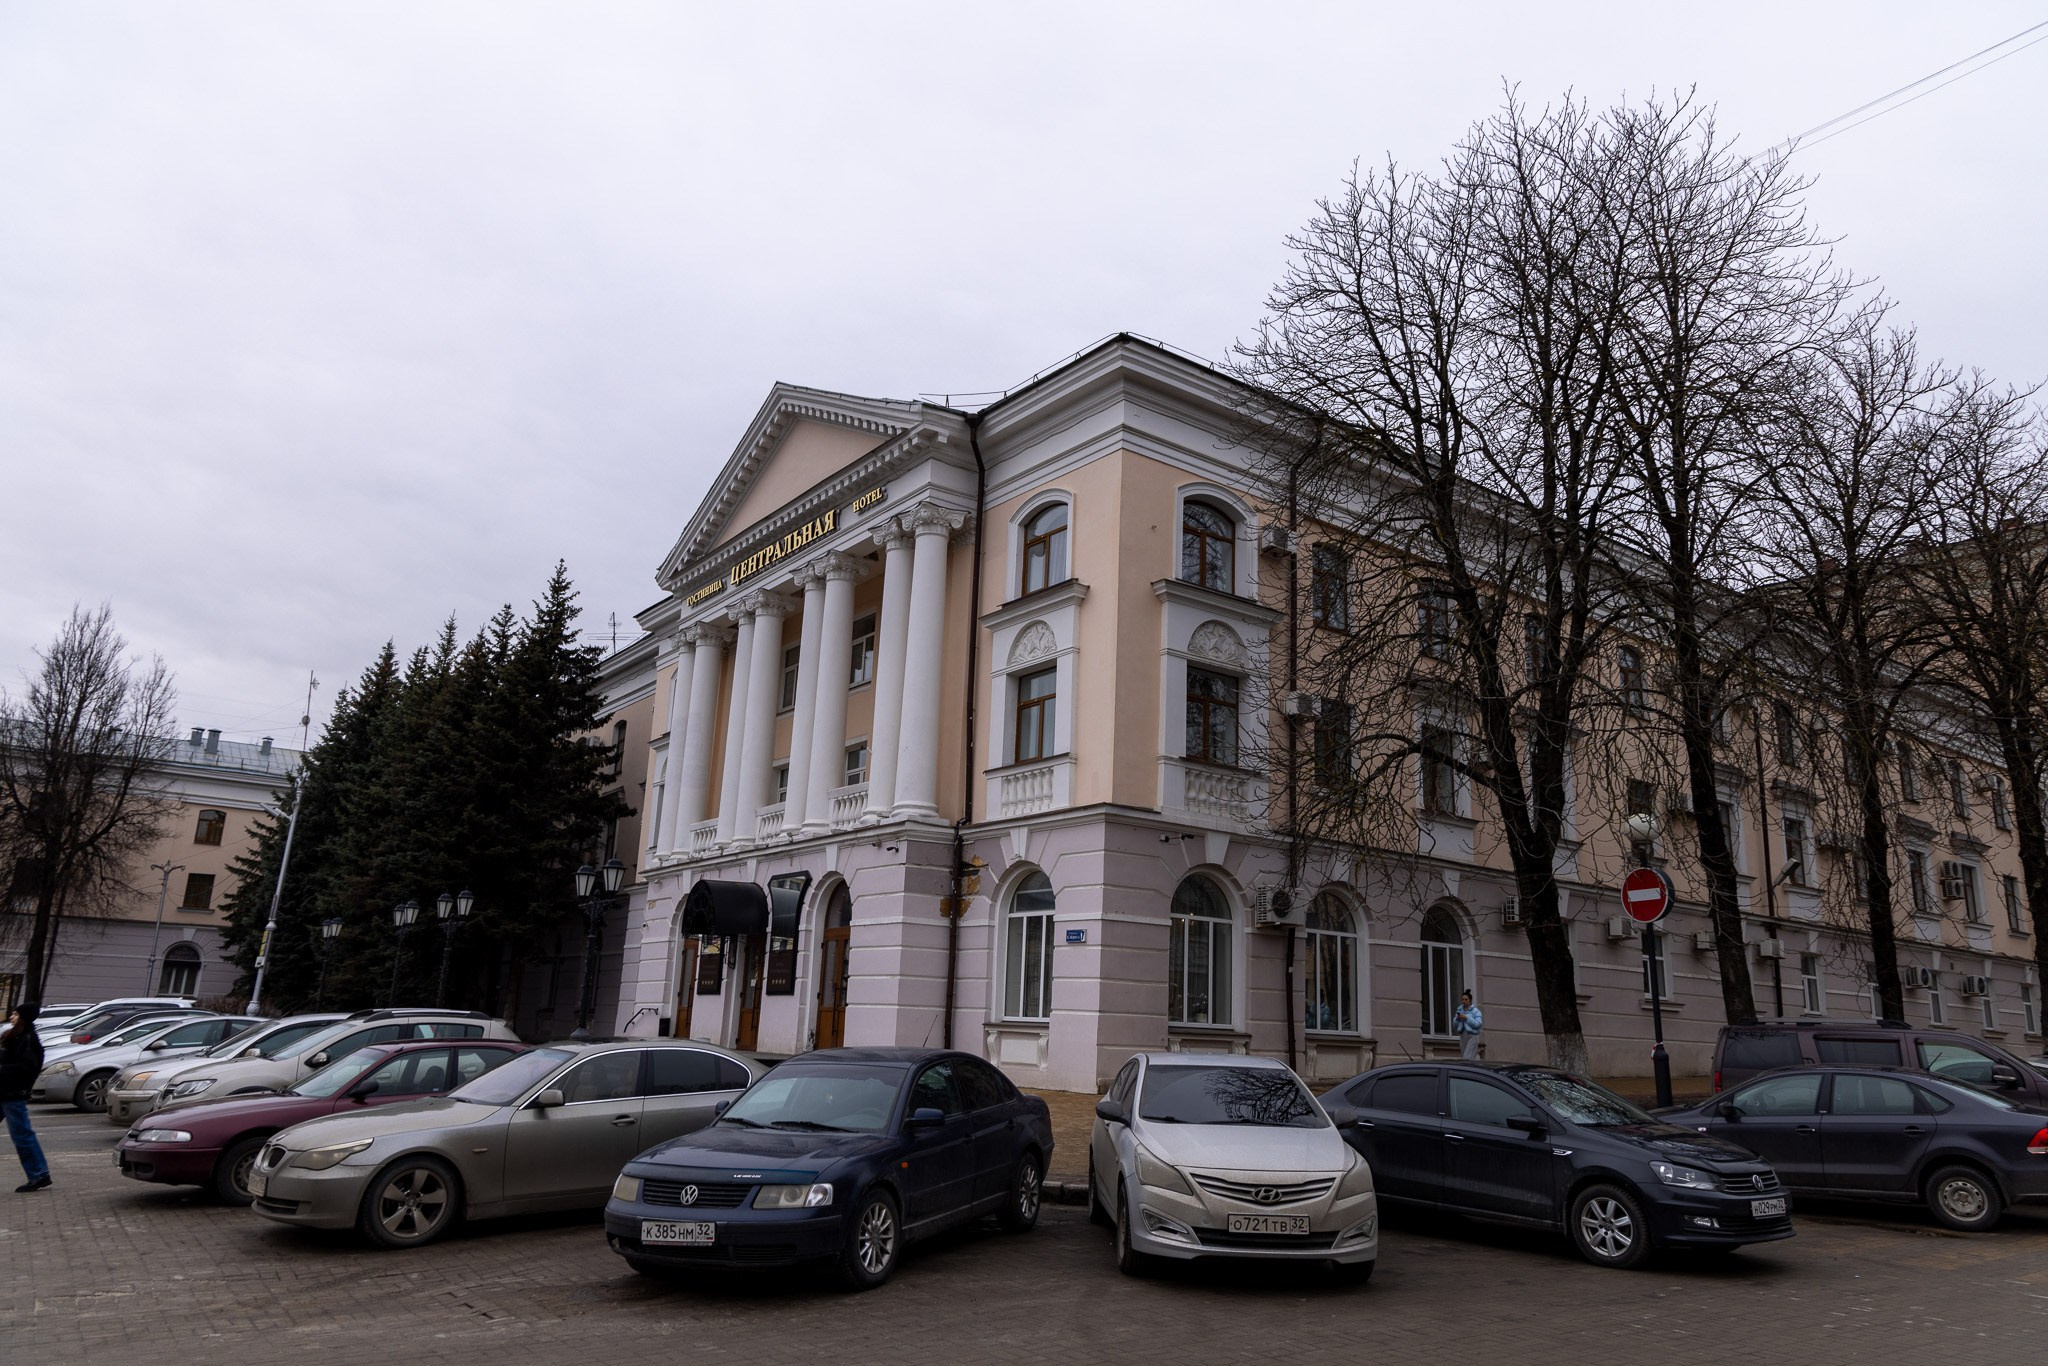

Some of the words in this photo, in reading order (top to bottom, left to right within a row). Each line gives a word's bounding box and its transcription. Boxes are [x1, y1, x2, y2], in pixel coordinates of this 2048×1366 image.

[853, 487, 882, 513] HOTEL
[686, 579, 723, 607] ГОСТИНИЦА
[730, 509, 835, 586] ЦЕНТРАЛЬНАЯ
[646, 1224, 694, 1240] К385НМ
[697, 1224, 710, 1236] 32
[1233, 1217, 1288, 1232] О721ТВ
[1291, 1218, 1305, 1229] 32
